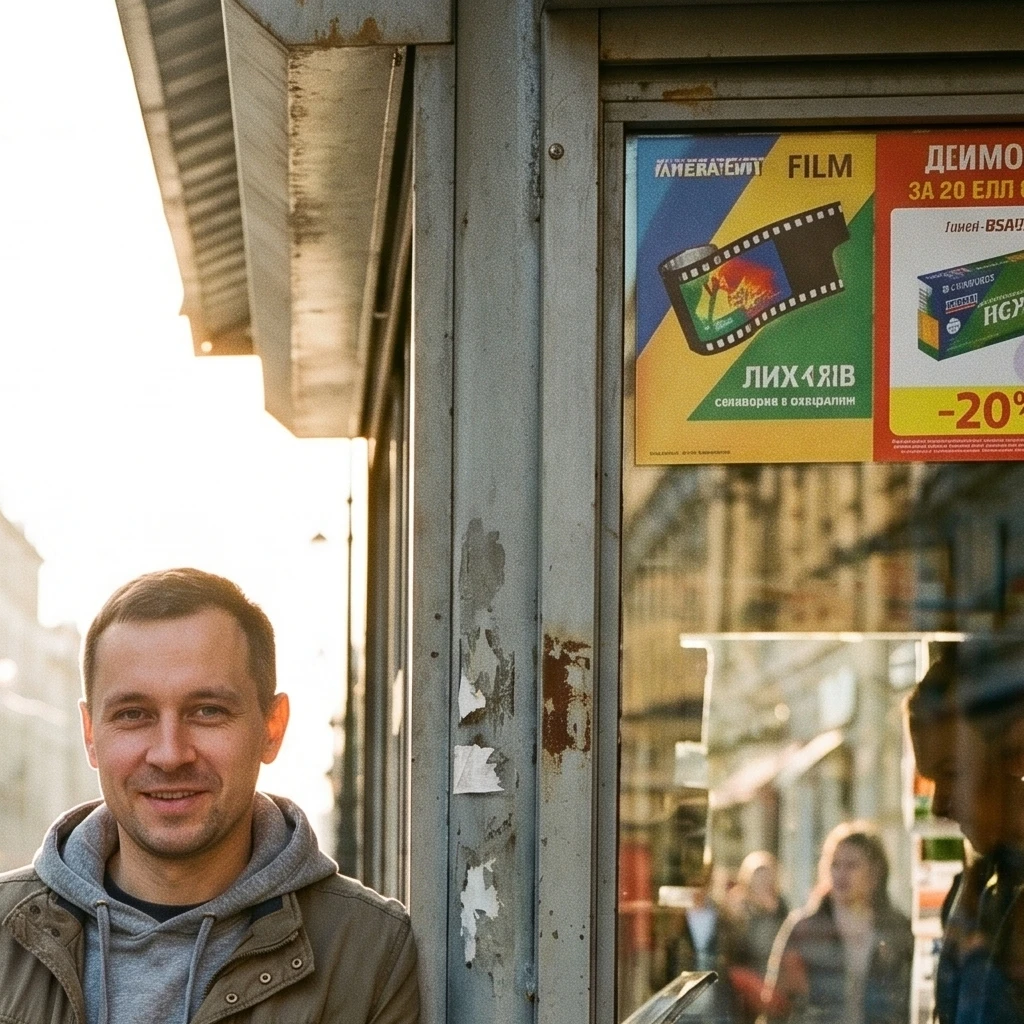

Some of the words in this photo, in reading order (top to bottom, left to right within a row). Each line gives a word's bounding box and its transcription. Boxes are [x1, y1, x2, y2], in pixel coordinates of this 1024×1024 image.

[788, 153, 853, 179] FILM
[908, 181, 935, 200] ЗА
[939, 181, 966, 200] 20
[938, 391, 1024, 430] -20
